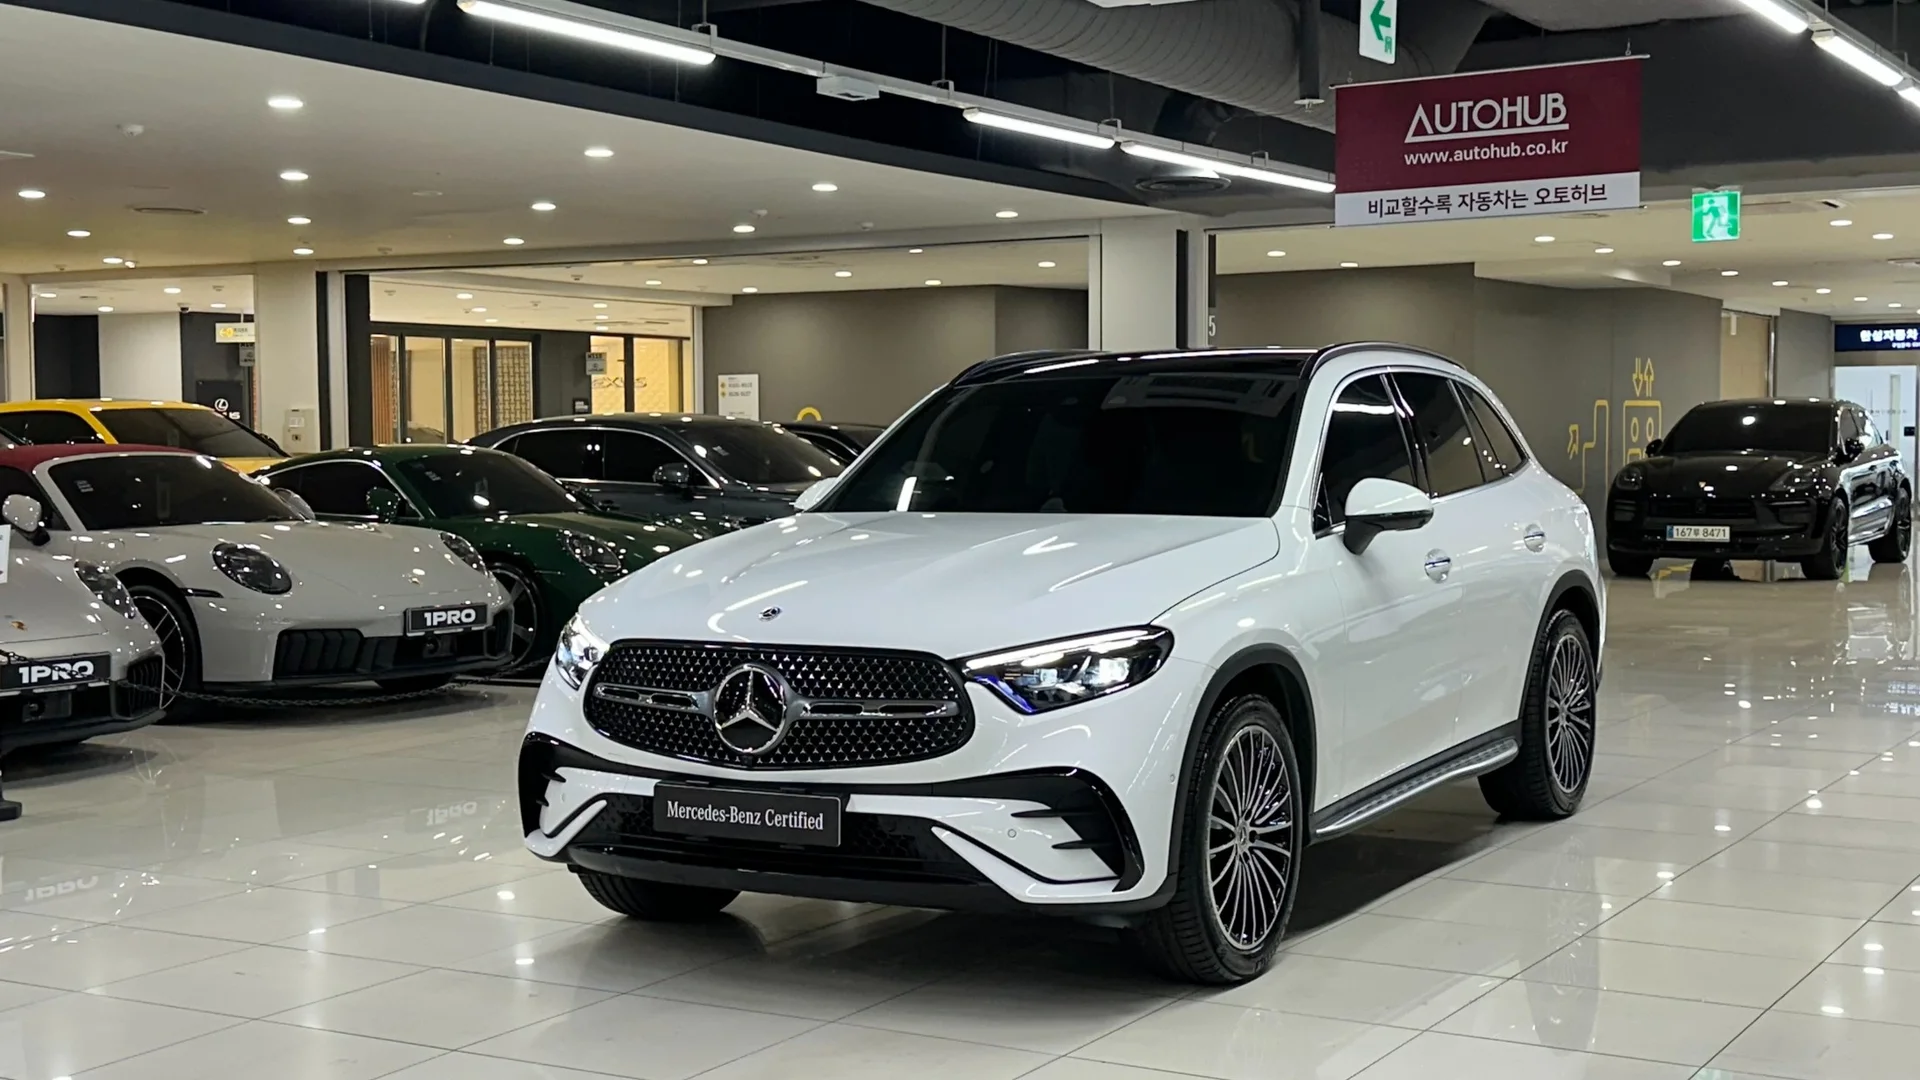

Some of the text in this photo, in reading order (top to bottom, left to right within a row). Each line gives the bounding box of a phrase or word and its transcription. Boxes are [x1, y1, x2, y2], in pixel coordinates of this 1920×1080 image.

[1404, 92, 1569, 143] AUTOHUB
[1404, 138, 1569, 165] www.autohub.co.kr
[1368, 184, 1608, 218] 비교할수록 자동차는 오토허브
[1702, 528, 1726, 538] 8471
[424, 608, 476, 627] 1PRO
[19, 660, 94, 684] 1PRO
[667, 800, 824, 831] Mercedes-Benz Certified
